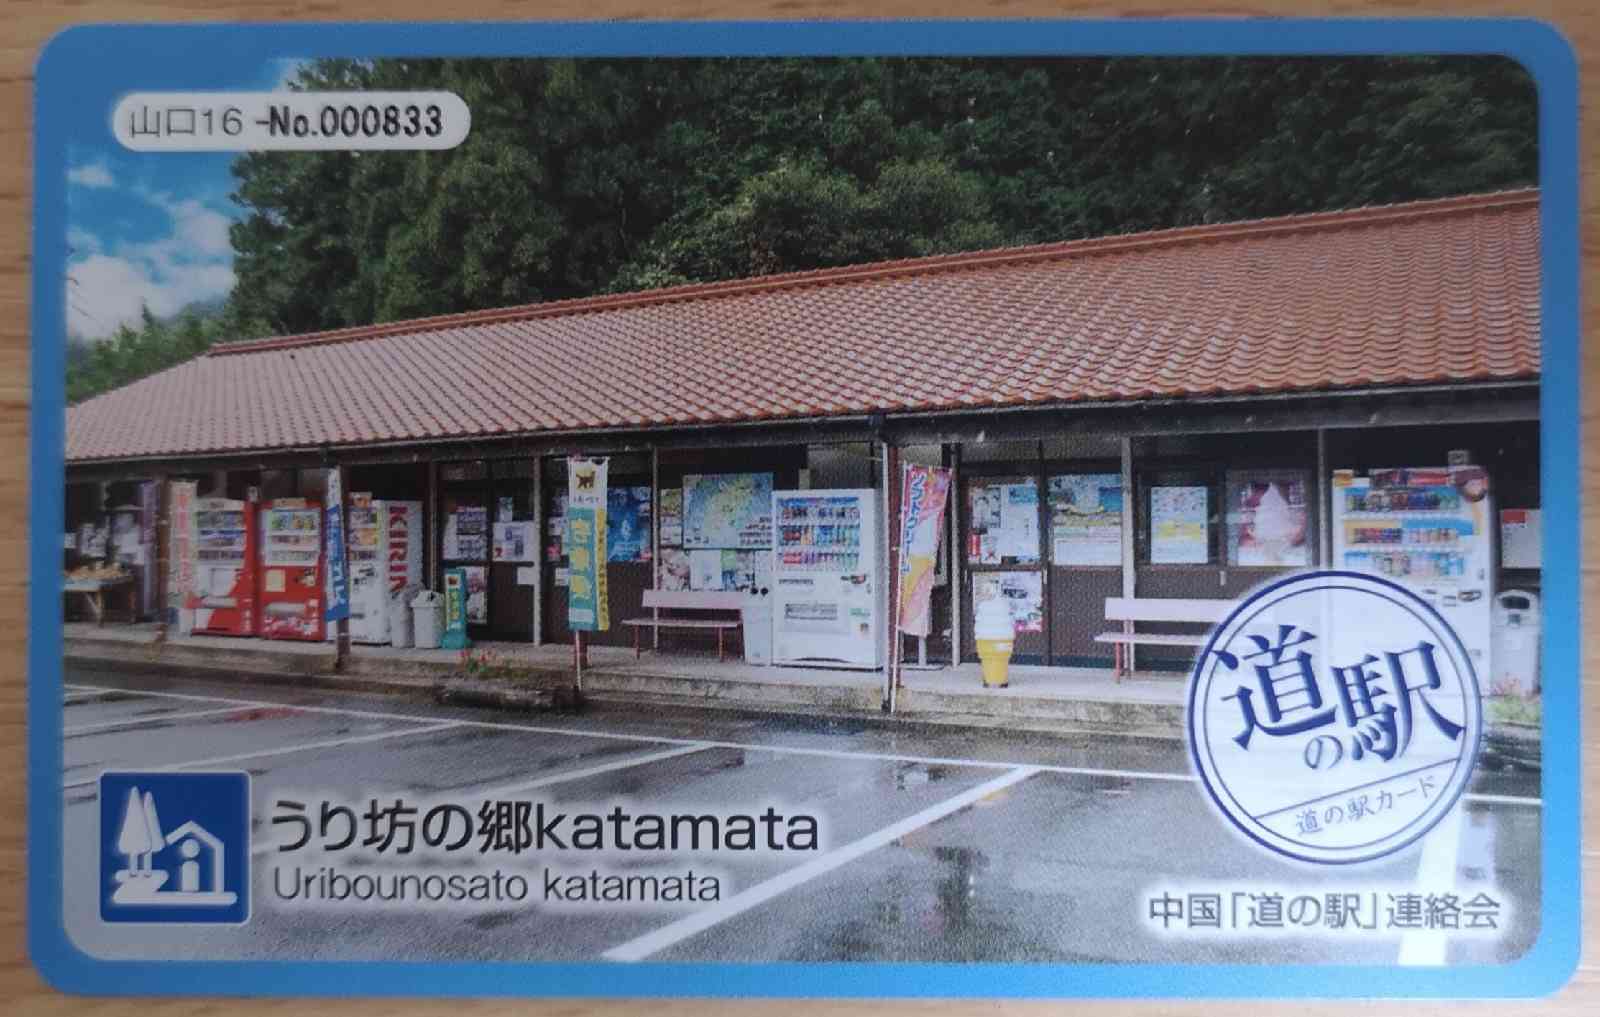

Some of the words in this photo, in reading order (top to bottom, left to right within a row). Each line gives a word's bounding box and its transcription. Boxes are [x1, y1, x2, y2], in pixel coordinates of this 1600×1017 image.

[130, 105, 243, 138] 山口16
[389, 506, 409, 599] KIRIN
[1211, 624, 1465, 770] 道の駅
[272, 799, 819, 854] うり坊の郷katamata
[1296, 775, 1436, 835] 道の駅カード
[274, 866, 528, 901] Uribounosato
[544, 867, 720, 902] katamata
[1149, 891, 1501, 930] 中国「道の駅」連絡会
